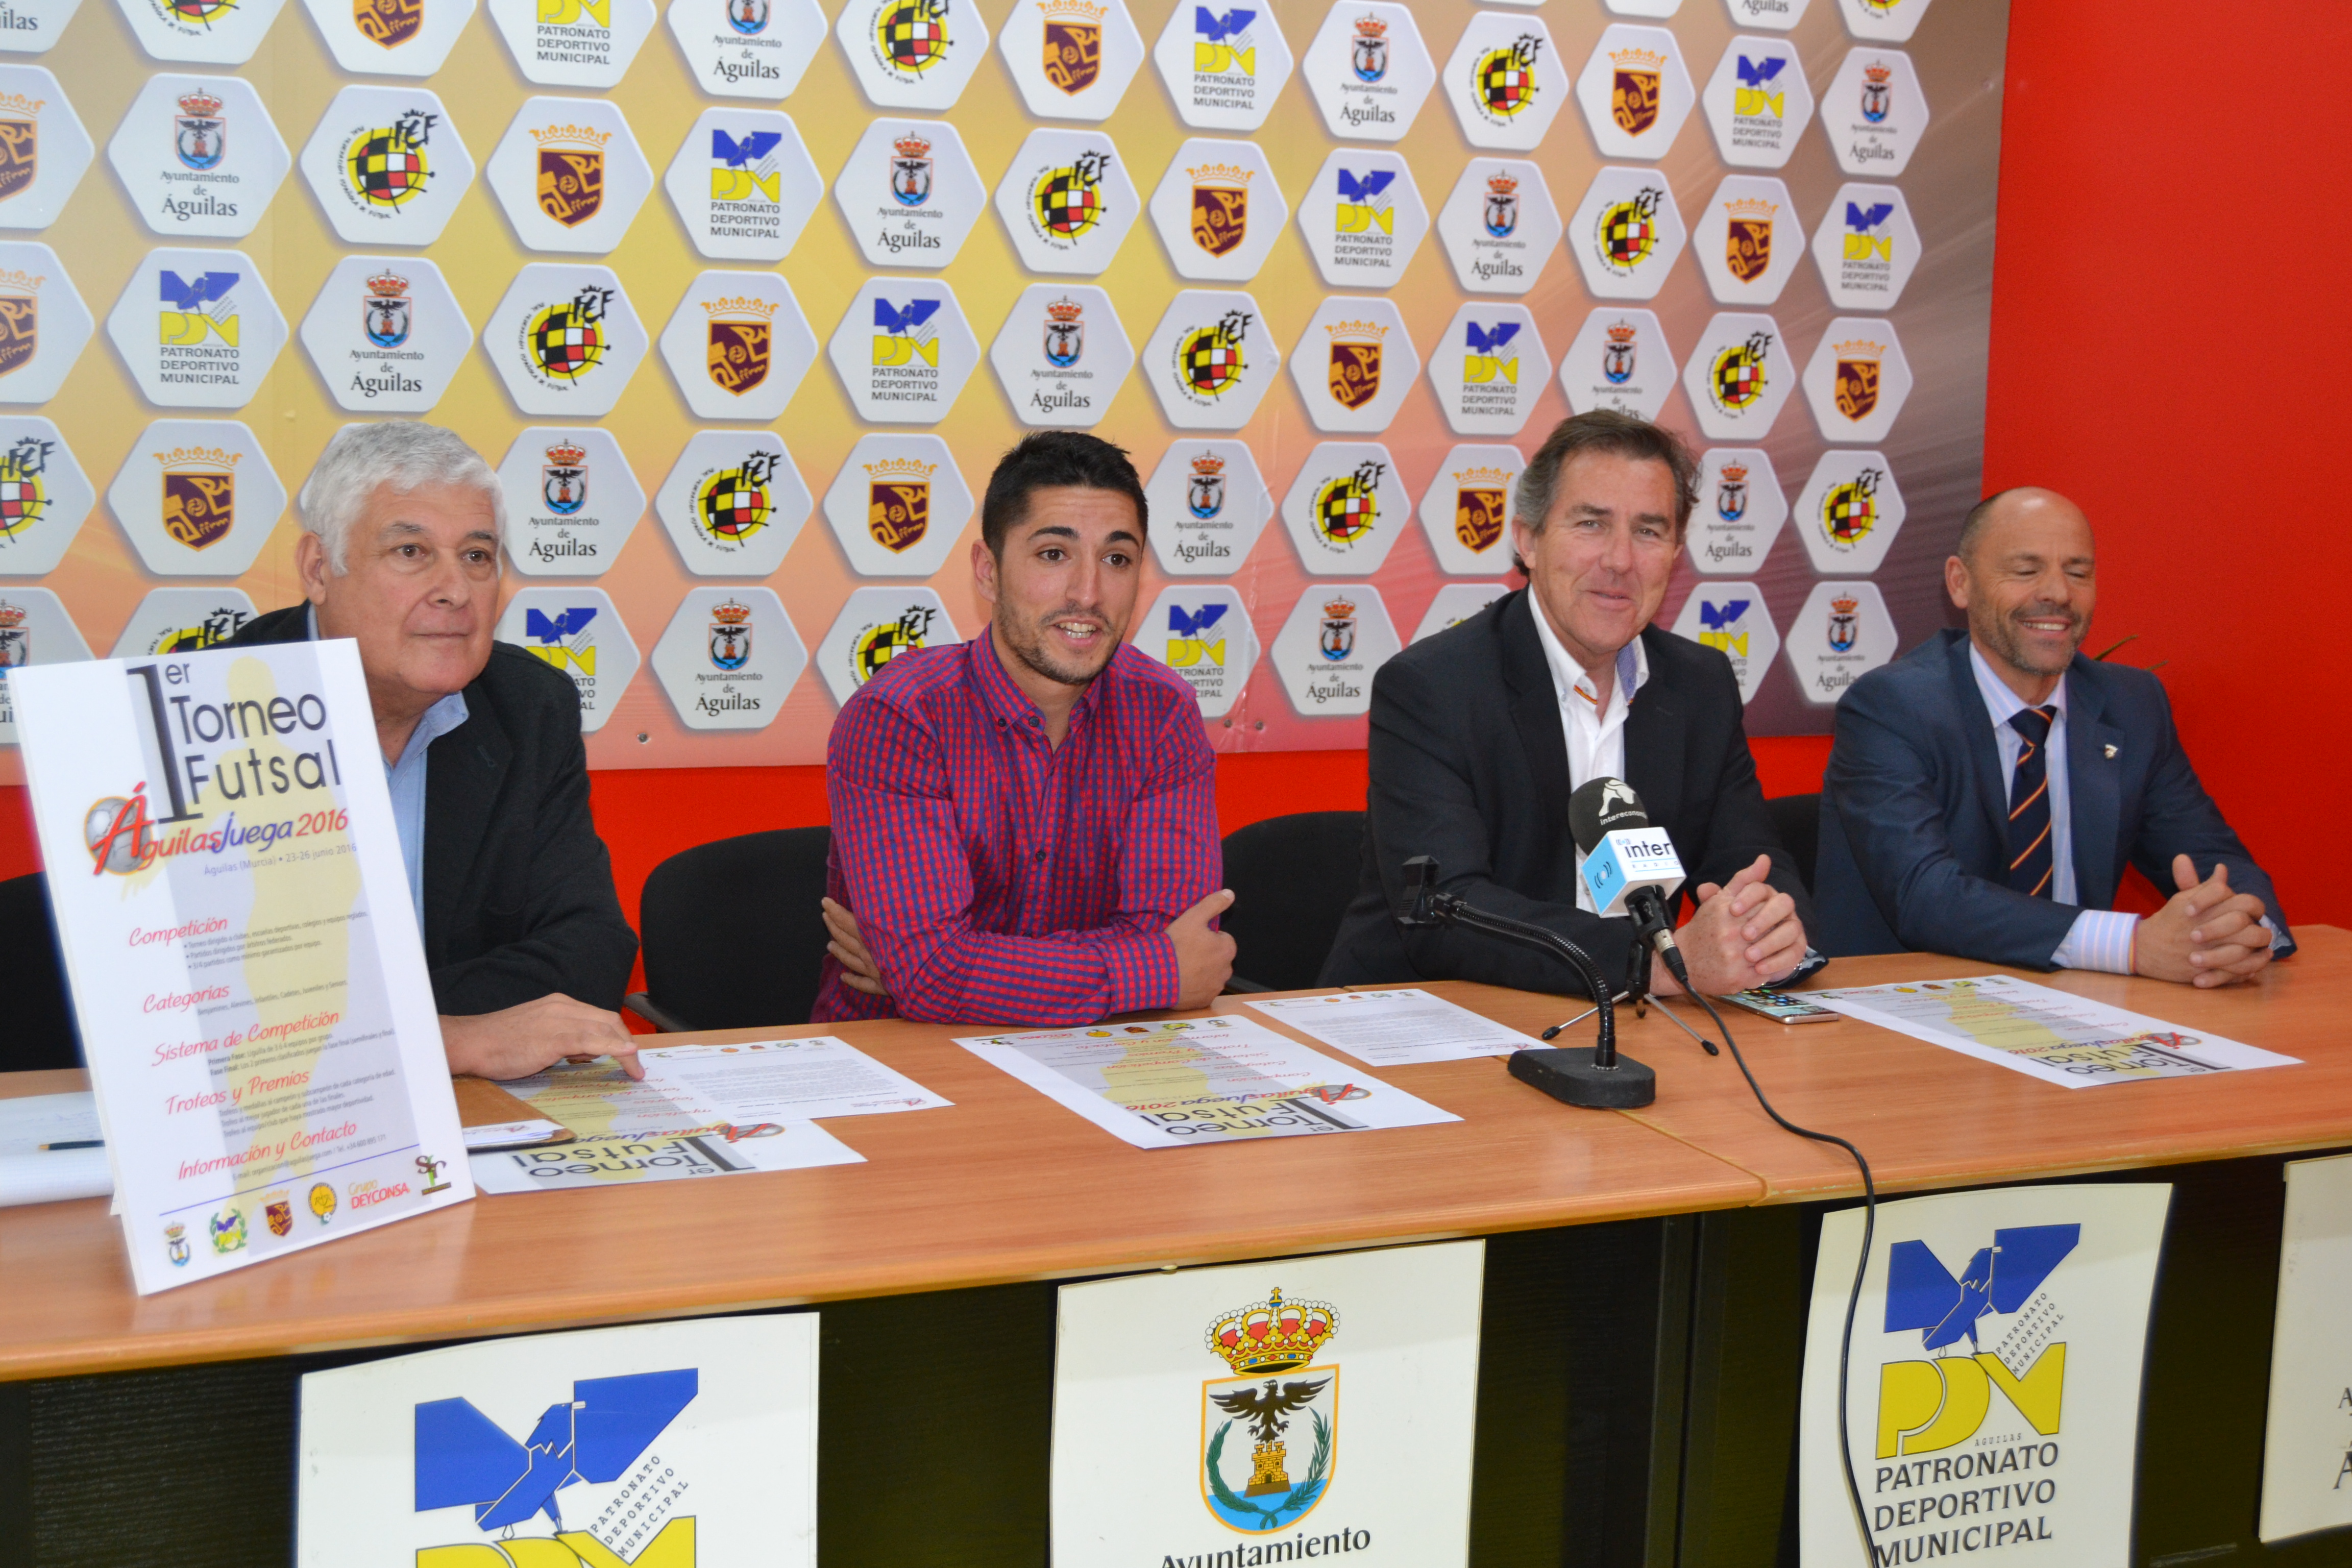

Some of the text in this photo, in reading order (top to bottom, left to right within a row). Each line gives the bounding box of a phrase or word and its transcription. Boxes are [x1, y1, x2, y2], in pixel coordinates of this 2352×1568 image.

[0, 8, 38, 31] ilas
[537, 24, 610, 39] PATRONATO
[537, 38, 610, 53] DEPORTIVO
[713, 34, 782, 48] Ayuntamiento
[536, 51, 610, 65] MUNICIPAL
[741, 48, 753, 59] de
[713, 56, 780, 83] Águilas
[1194, 73, 1255, 87] PATRONATO
[1193, 85, 1255, 99] DEPORTIVO
[1341, 82, 1398, 94] Ayuntamiento
[1193, 96, 1254, 110] MUNICIPAL
[1340, 102, 1396, 127] Águilas
[1733, 116, 1783, 129] PATRONATO
[1732, 127, 1783, 139] DEPORTIVO
[1732, 137, 1781, 150] MUNICIPAL
[1849, 142, 1896, 164] Águilas
[161, 169, 239, 185] Ayuntamiento
[193, 184, 207, 196] de
[161, 193, 238, 222] Águilas
[710, 201, 780, 214] PATRONATO
[877, 206, 943, 219] Ayuntamiento
[710, 214, 780, 226] DEPORTIVO
[904, 219, 915, 230] de
[710, 226, 779, 238] MUNICIPAL
[877, 228, 941, 253] Águilas
[1335, 233, 1393, 246] PATRONATO
[1473, 239, 1526, 249] Ayuntamiento
[1334, 245, 1393, 257] DEPORTIVO
[1334, 256, 1392, 268] MUNICIPAL
[1471, 257, 1524, 281] Águilas
[1842, 260, 1891, 272] PATRONATO
[1842, 271, 1891, 282] DEPORTIVO
[1841, 281, 1889, 292] MUNICIPAL
[160, 347, 239, 359] PATRONATO
[349, 349, 425, 363] Ayuntamiento
[160, 360, 239, 372] DEPORTIVO
[380, 362, 394, 372] de
[872, 367, 939, 378] PATRONATO
[160, 373, 239, 385] MUNICIPAL
[1031, 369, 1093, 381] Ayuntamiento
[350, 372, 422, 397] Águilas
[872, 379, 938, 390] DEPORTIVO
[1056, 380, 1067, 390] de
[1463, 384, 1517, 395] PATRONATO
[871, 391, 937, 402] MUNICIPAL
[1030, 389, 1091, 413] Águilas
[1462, 395, 1516, 405] DEPORTIVO
[1461, 406, 1515, 416] MUNICIPAL
[528, 517, 600, 529] Ayuntamiento
[1175, 521, 1234, 532] Ayuntamiento
[557, 528, 570, 538] de
[528, 538, 597, 562] Águilas
[1173, 540, 1231, 564] Águilas
[1705, 541, 1753, 563] Águilas
[1176, 668, 1224, 676] TRONATO
[1306, 662, 1364, 674] Ayuntamiento
[695, 672, 763, 684] Ayuntamiento
[1187, 678, 1223, 687] ORTIVO
[1816, 672, 1858, 692] Águila
[722, 683, 734, 693] de
[1196, 690, 1222, 698] CIPAL
[1306, 681, 1361, 704] Águilas
[695, 693, 761, 716] Águilas
[169, 694, 326, 745] Torneo
[126, 663, 204, 824] 1 er
[184, 739, 341, 804] Futsal
[296, 808, 348, 838] 2016
[1625, 841, 1671, 858] inter
[204, 843, 357, 876] Águilas (Murcia) 23-26 junio 2016
[129, 917, 228, 947] Competición
[151, 1011, 339, 1067] Sistema de Competición
[2008, 1046, 2048, 1055] 2016
[2029, 1046, 2155, 1066] Futsal
[208, 1055, 231, 1066] Primera
[2065, 1058, 2189, 1074] Torneo
[1227, 1072, 1311, 1083] Competición
[231, 1087, 243, 1107] y
[248, 1070, 310, 1095] Premios
[1125, 1101, 1177, 1111] 2016
[1140, 1102, 1290, 1126] Futsal
[1166, 1115, 1322, 1135] Torneo
[178, 1120, 357, 1180] Información y Contacto
[512, 1141, 691, 1167] Futsal
[529, 1155, 708, 1177] Torneo
[348, 1179, 379, 1196] Grupo
[351, 1182, 410, 1210] DEYCONSA
[1996, 1293, 2046, 1354] PATRONATO
[2004, 1303, 2055, 1364] DEPORTIVO
[2012, 1314, 2064, 1375] MUNICIPAL
[1974, 1433, 2022, 1447] AGUILAS
[1875, 1441, 2059, 1493] PATRONATO
[590, 1456, 660, 1533] PATRONATO
[604, 1468, 674, 1546] DEPORTIVO
[1874, 1479, 2055, 1532] DEPORTIVO
[617, 1481, 689, 1558] MUNICIPAL
[1874, 1515, 2052, 1568] MUNICIPAL
